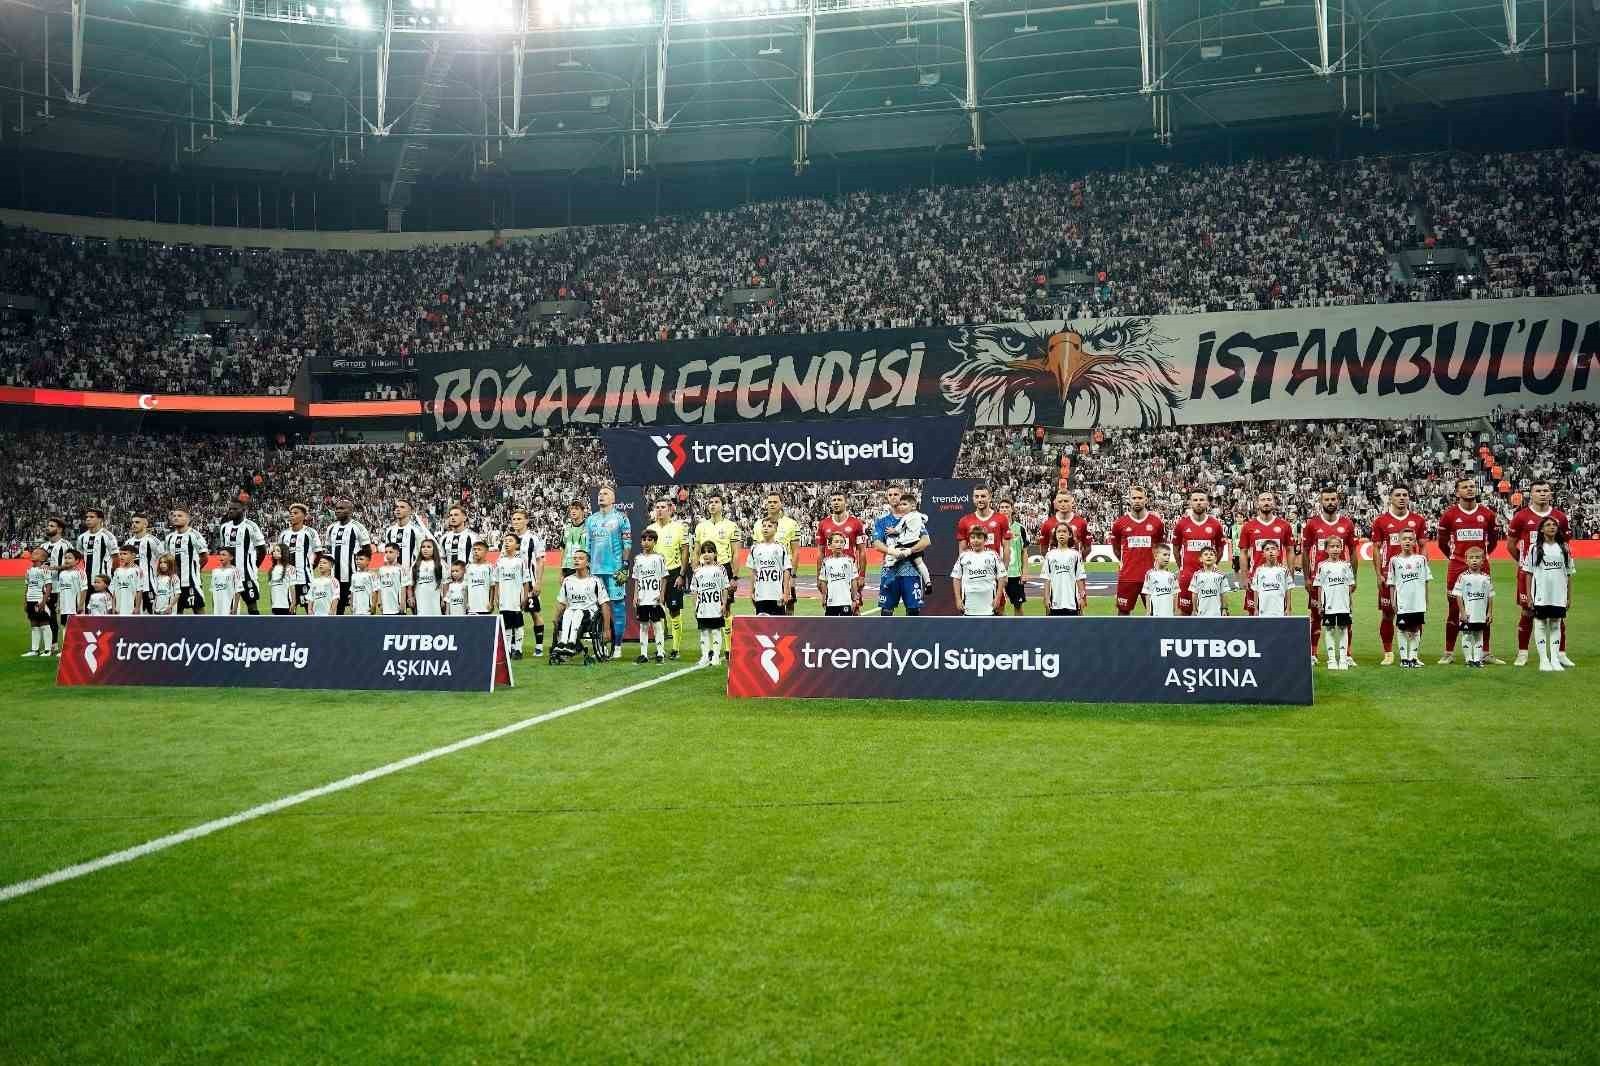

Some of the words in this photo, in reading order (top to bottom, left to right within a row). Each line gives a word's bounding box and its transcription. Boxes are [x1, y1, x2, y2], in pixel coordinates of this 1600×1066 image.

[433, 360, 665, 432] BOĞAZIN
[673, 341, 929, 424] EFENDİSİ
[691, 436, 812, 467] trendyol
[815, 437, 914, 464] SüperLig
[932, 494, 969, 504] trendyol
[1401, 572, 1418, 580] beko
[249, 590, 255, 598] 6
[529, 599, 534, 608] 2
[912, 588, 922, 600] 13
[383, 634, 458, 652] FUTBOL
[1160, 638, 1261, 658] FUTBOL
[116, 638, 221, 667] trendyol
[222, 642, 309, 669] SüperLig
[801, 642, 940, 676] trendyol
[944, 647, 1060, 678] SüperLig
[383, 659, 453, 681] AŞKINA
[1164, 667, 1258, 693] AŞKINA
